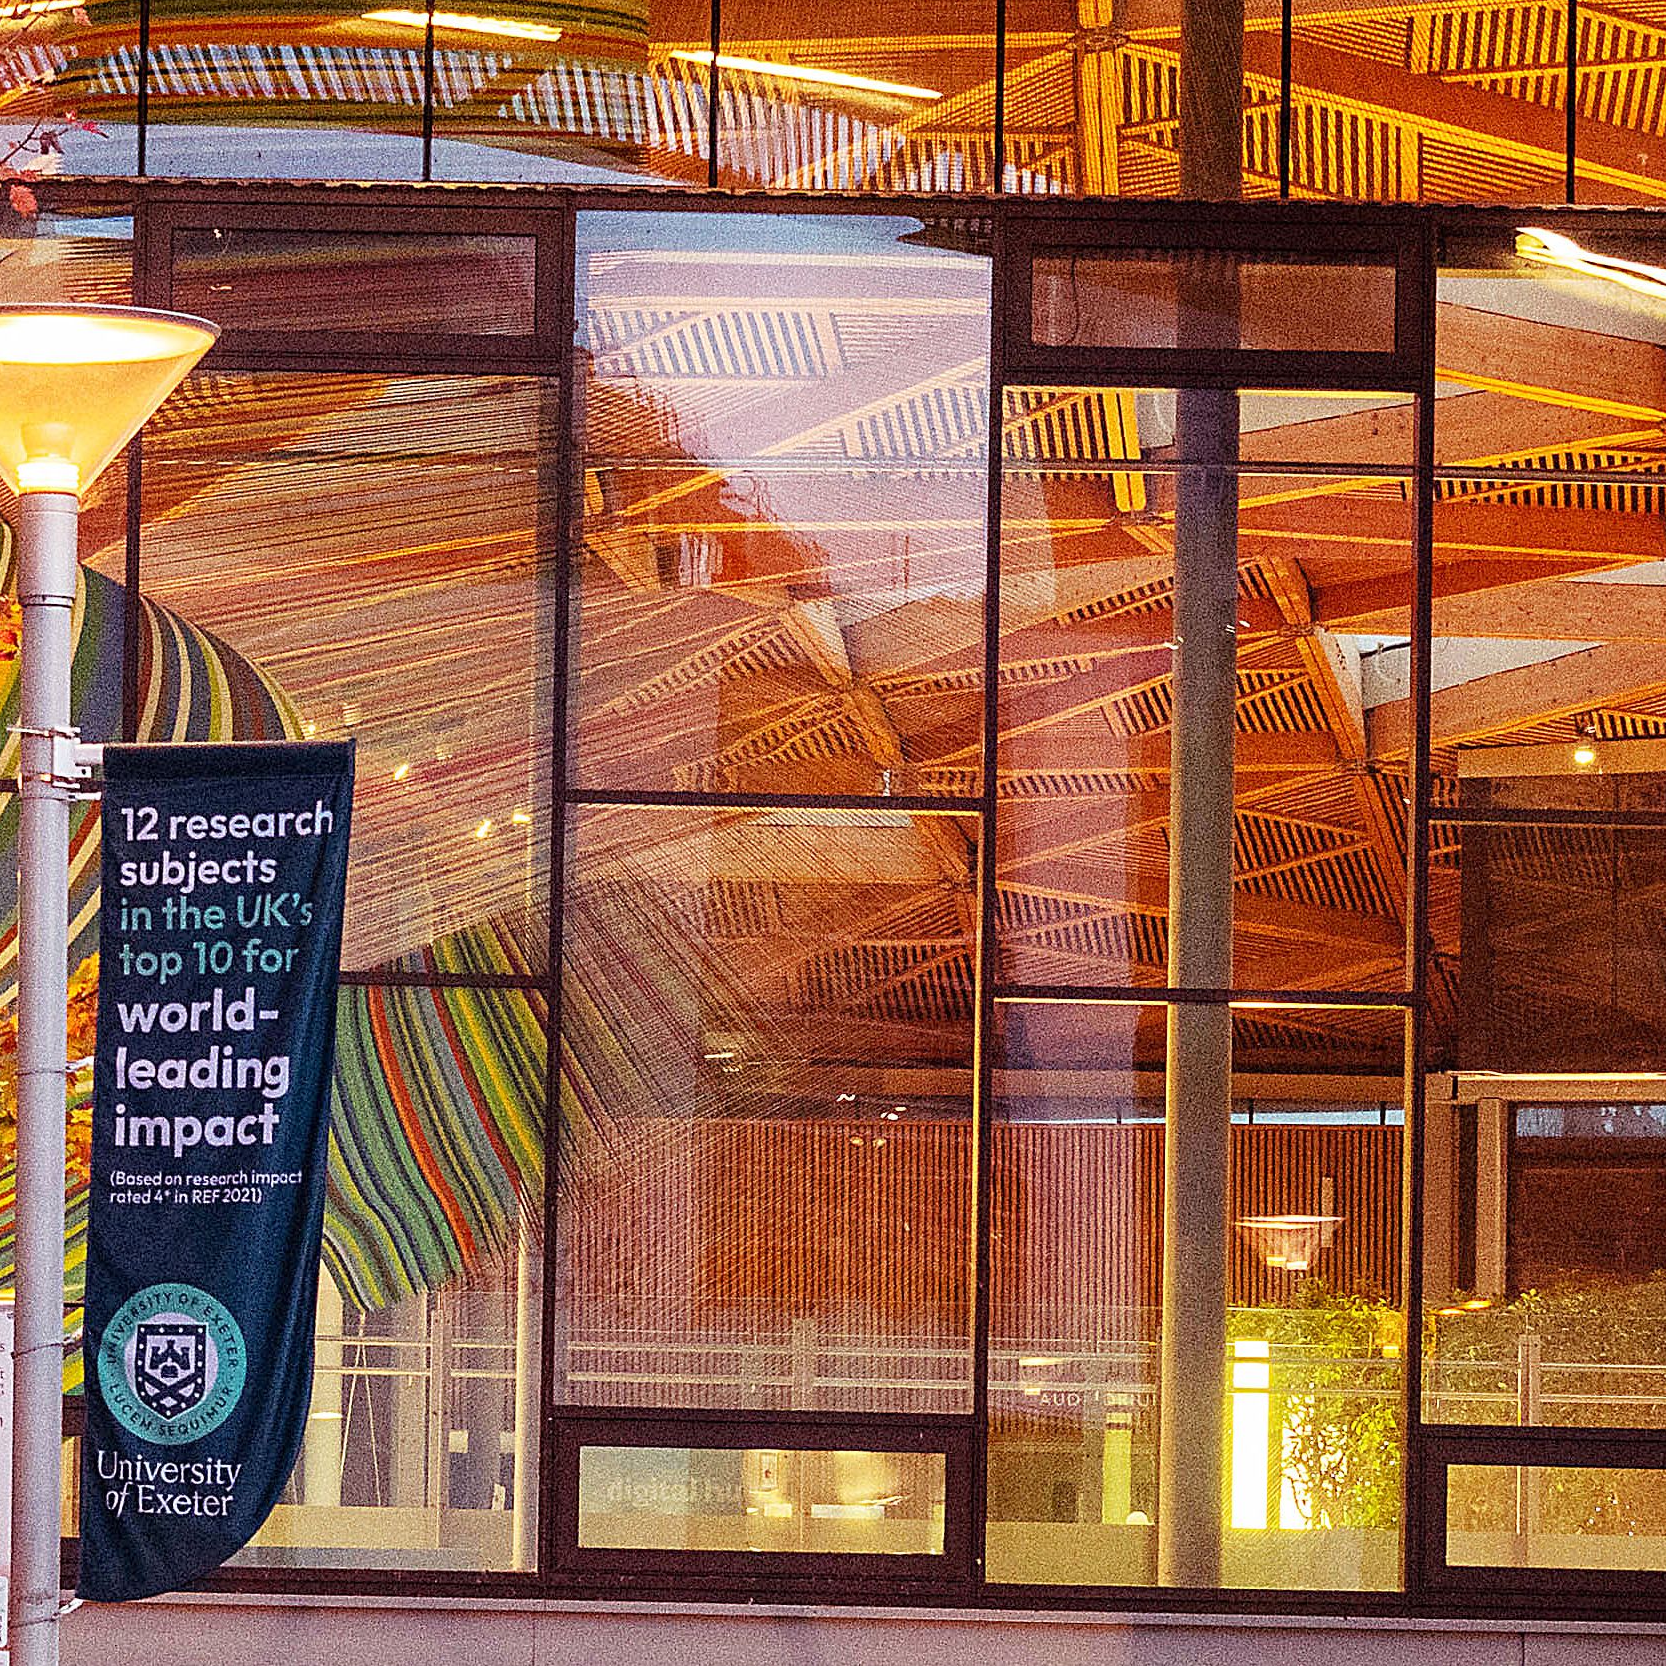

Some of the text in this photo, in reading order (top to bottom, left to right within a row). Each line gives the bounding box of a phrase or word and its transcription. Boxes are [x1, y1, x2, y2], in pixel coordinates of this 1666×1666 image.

[121, 800, 334, 842] 12 research
[120, 850, 278, 894] subjects
[121, 897, 152, 931] in
[162, 895, 226, 930] the
[119, 938, 299, 984] top 10 for
[116, 986, 280, 1033] world-
[116, 1044, 290, 1098] leading
[114, 1102, 280, 1158] impact
[110, 1169, 303, 1188] (Based on research impact
[110, 1190, 151, 1204] rated
[174, 1190, 188, 1203] in
[192, 1190, 221, 1204] REF
[222, 1188, 262, 1204] 2021)
[106, 1291, 239, 1367] UNIVERSITY OF EXETER
[108, 1383, 233, 1436] LUCEM SEQUIMUR
[98, 1449, 241, 1491] University
[106, 1481, 234, 1517] of Exeter
